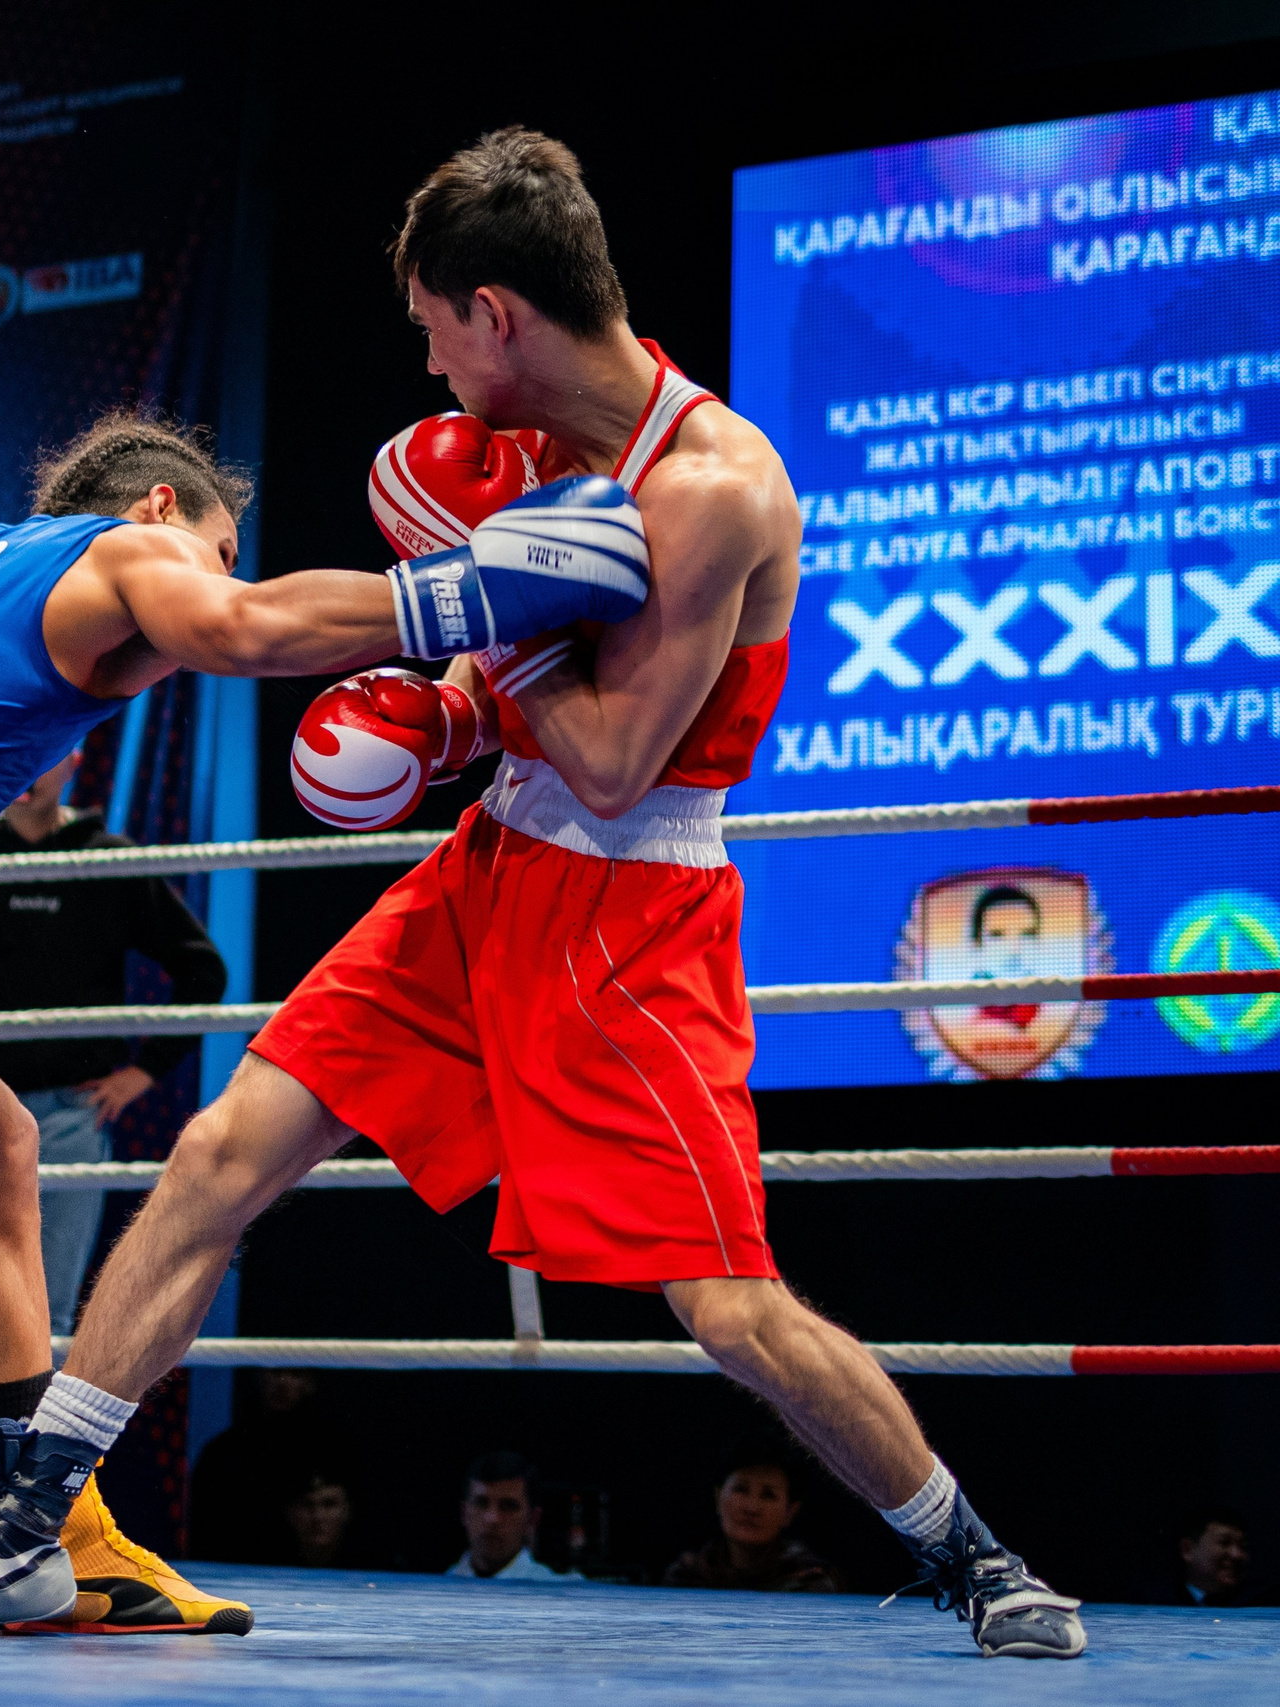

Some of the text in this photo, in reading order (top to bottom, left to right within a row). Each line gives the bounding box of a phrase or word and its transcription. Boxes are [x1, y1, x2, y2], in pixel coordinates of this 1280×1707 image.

[1213, 96, 1280, 144] ҚА
[828, 391, 940, 434] ҚАЗАҚ
[947, 383, 1014, 418] КСР
[865, 403, 1244, 473] ЖАТТЫҚТЫРУШЫСЫ
[395, 526, 425, 557] HILL
[396, 519, 435, 552] GREEN
[1173, 497, 1280, 538] БОКС
[827, 562, 1280, 694] XXXIX
[773, 696, 1161, 773] ХАЛЫҚАРАЛЫҚ
[1014, 1592, 1040, 1604] NIKE
